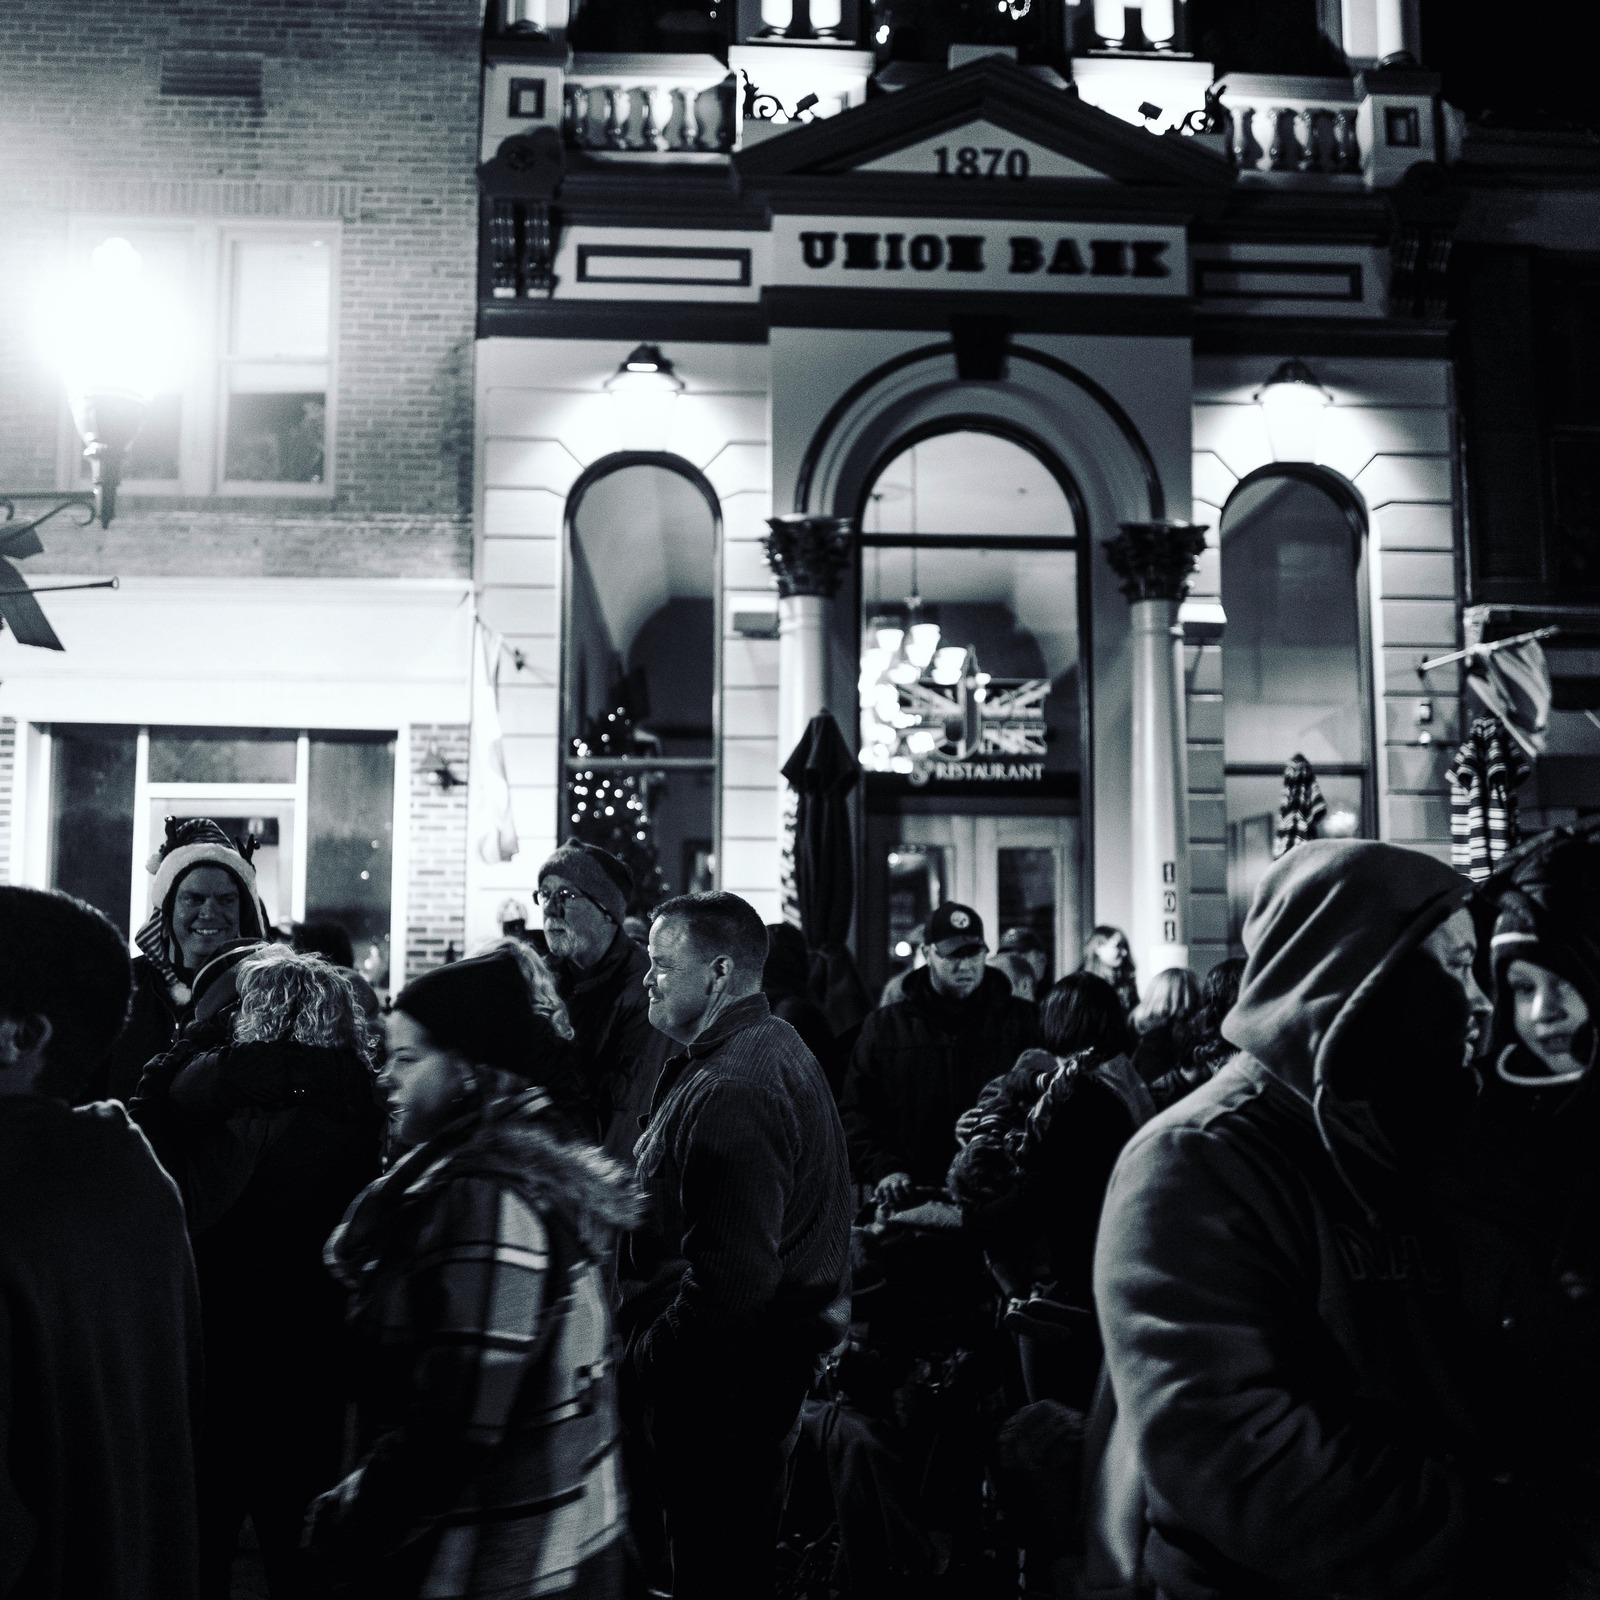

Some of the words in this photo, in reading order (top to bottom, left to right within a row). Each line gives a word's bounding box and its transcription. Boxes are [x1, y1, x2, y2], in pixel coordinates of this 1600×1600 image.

[934, 146, 1031, 181] 1870
[799, 231, 986, 272] UNION
[1008, 236, 1171, 278] BANK
[935, 761, 1044, 781] RESTAURANT
